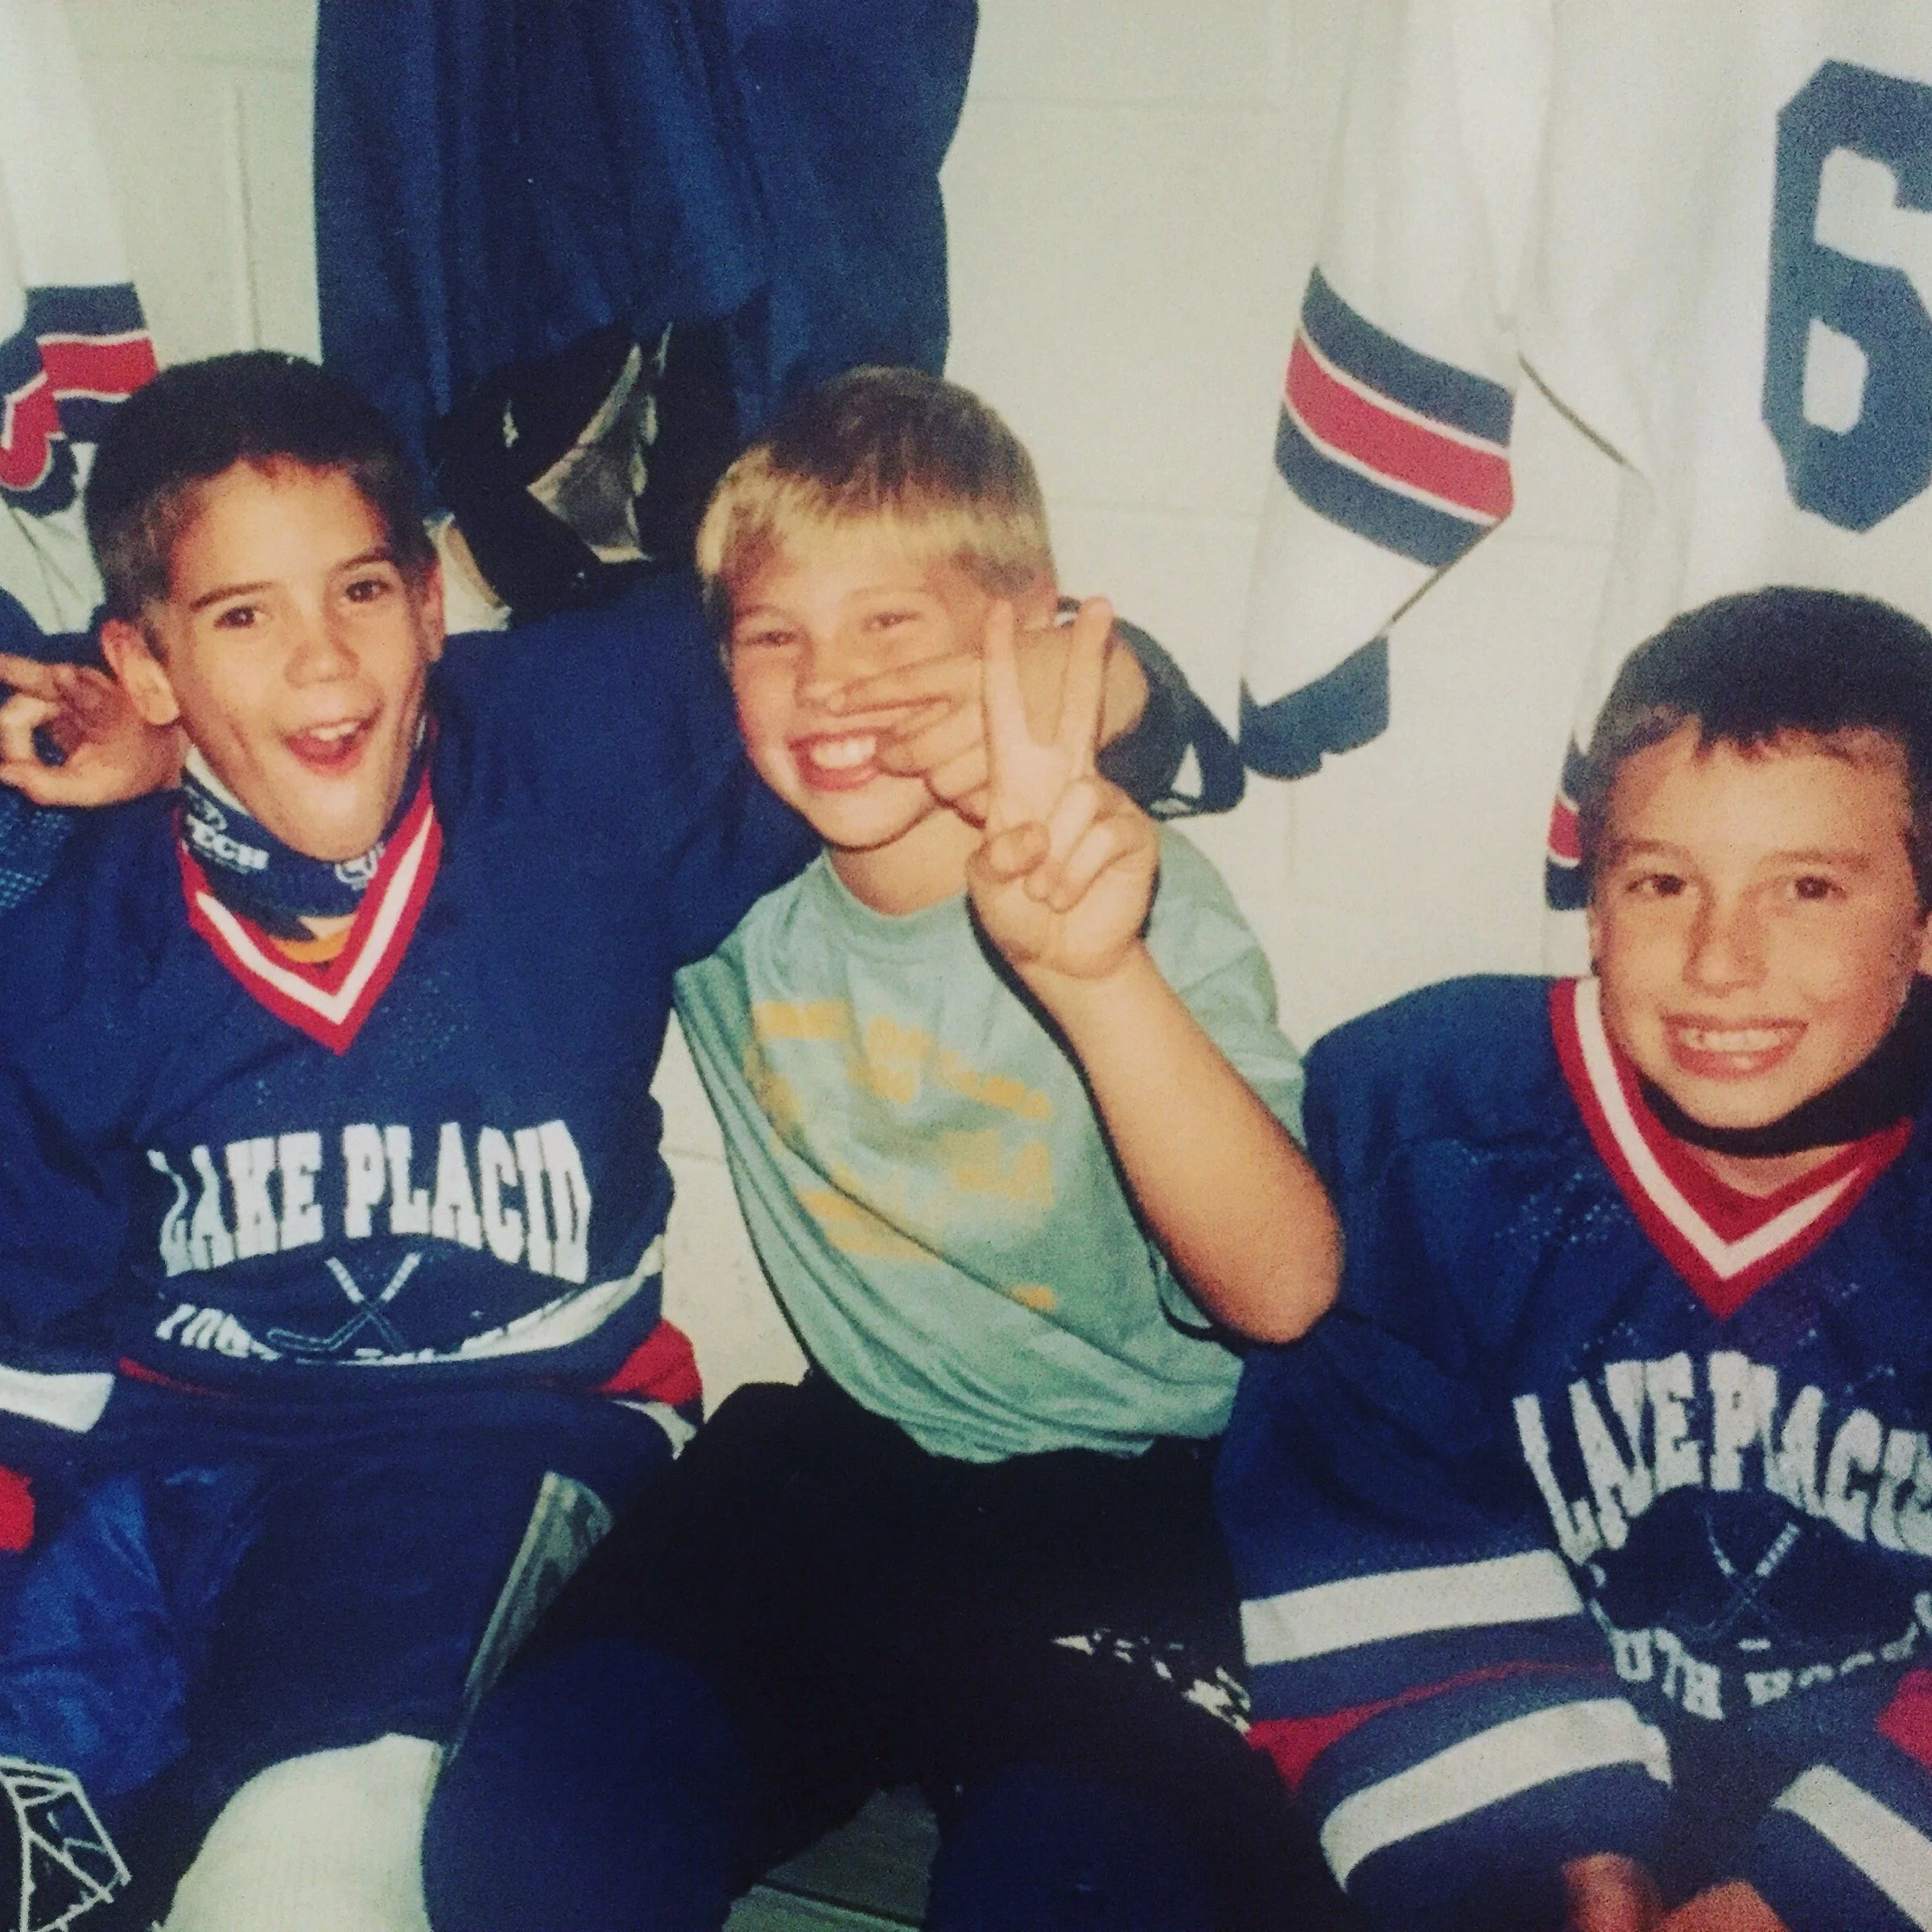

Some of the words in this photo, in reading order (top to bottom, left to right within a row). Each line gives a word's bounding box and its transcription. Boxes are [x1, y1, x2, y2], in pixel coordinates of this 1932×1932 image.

[1761, 59, 1932, 534] 6
[147, 1130, 325, 1278] LAKE
[341, 1119, 592, 1285] PLACID
